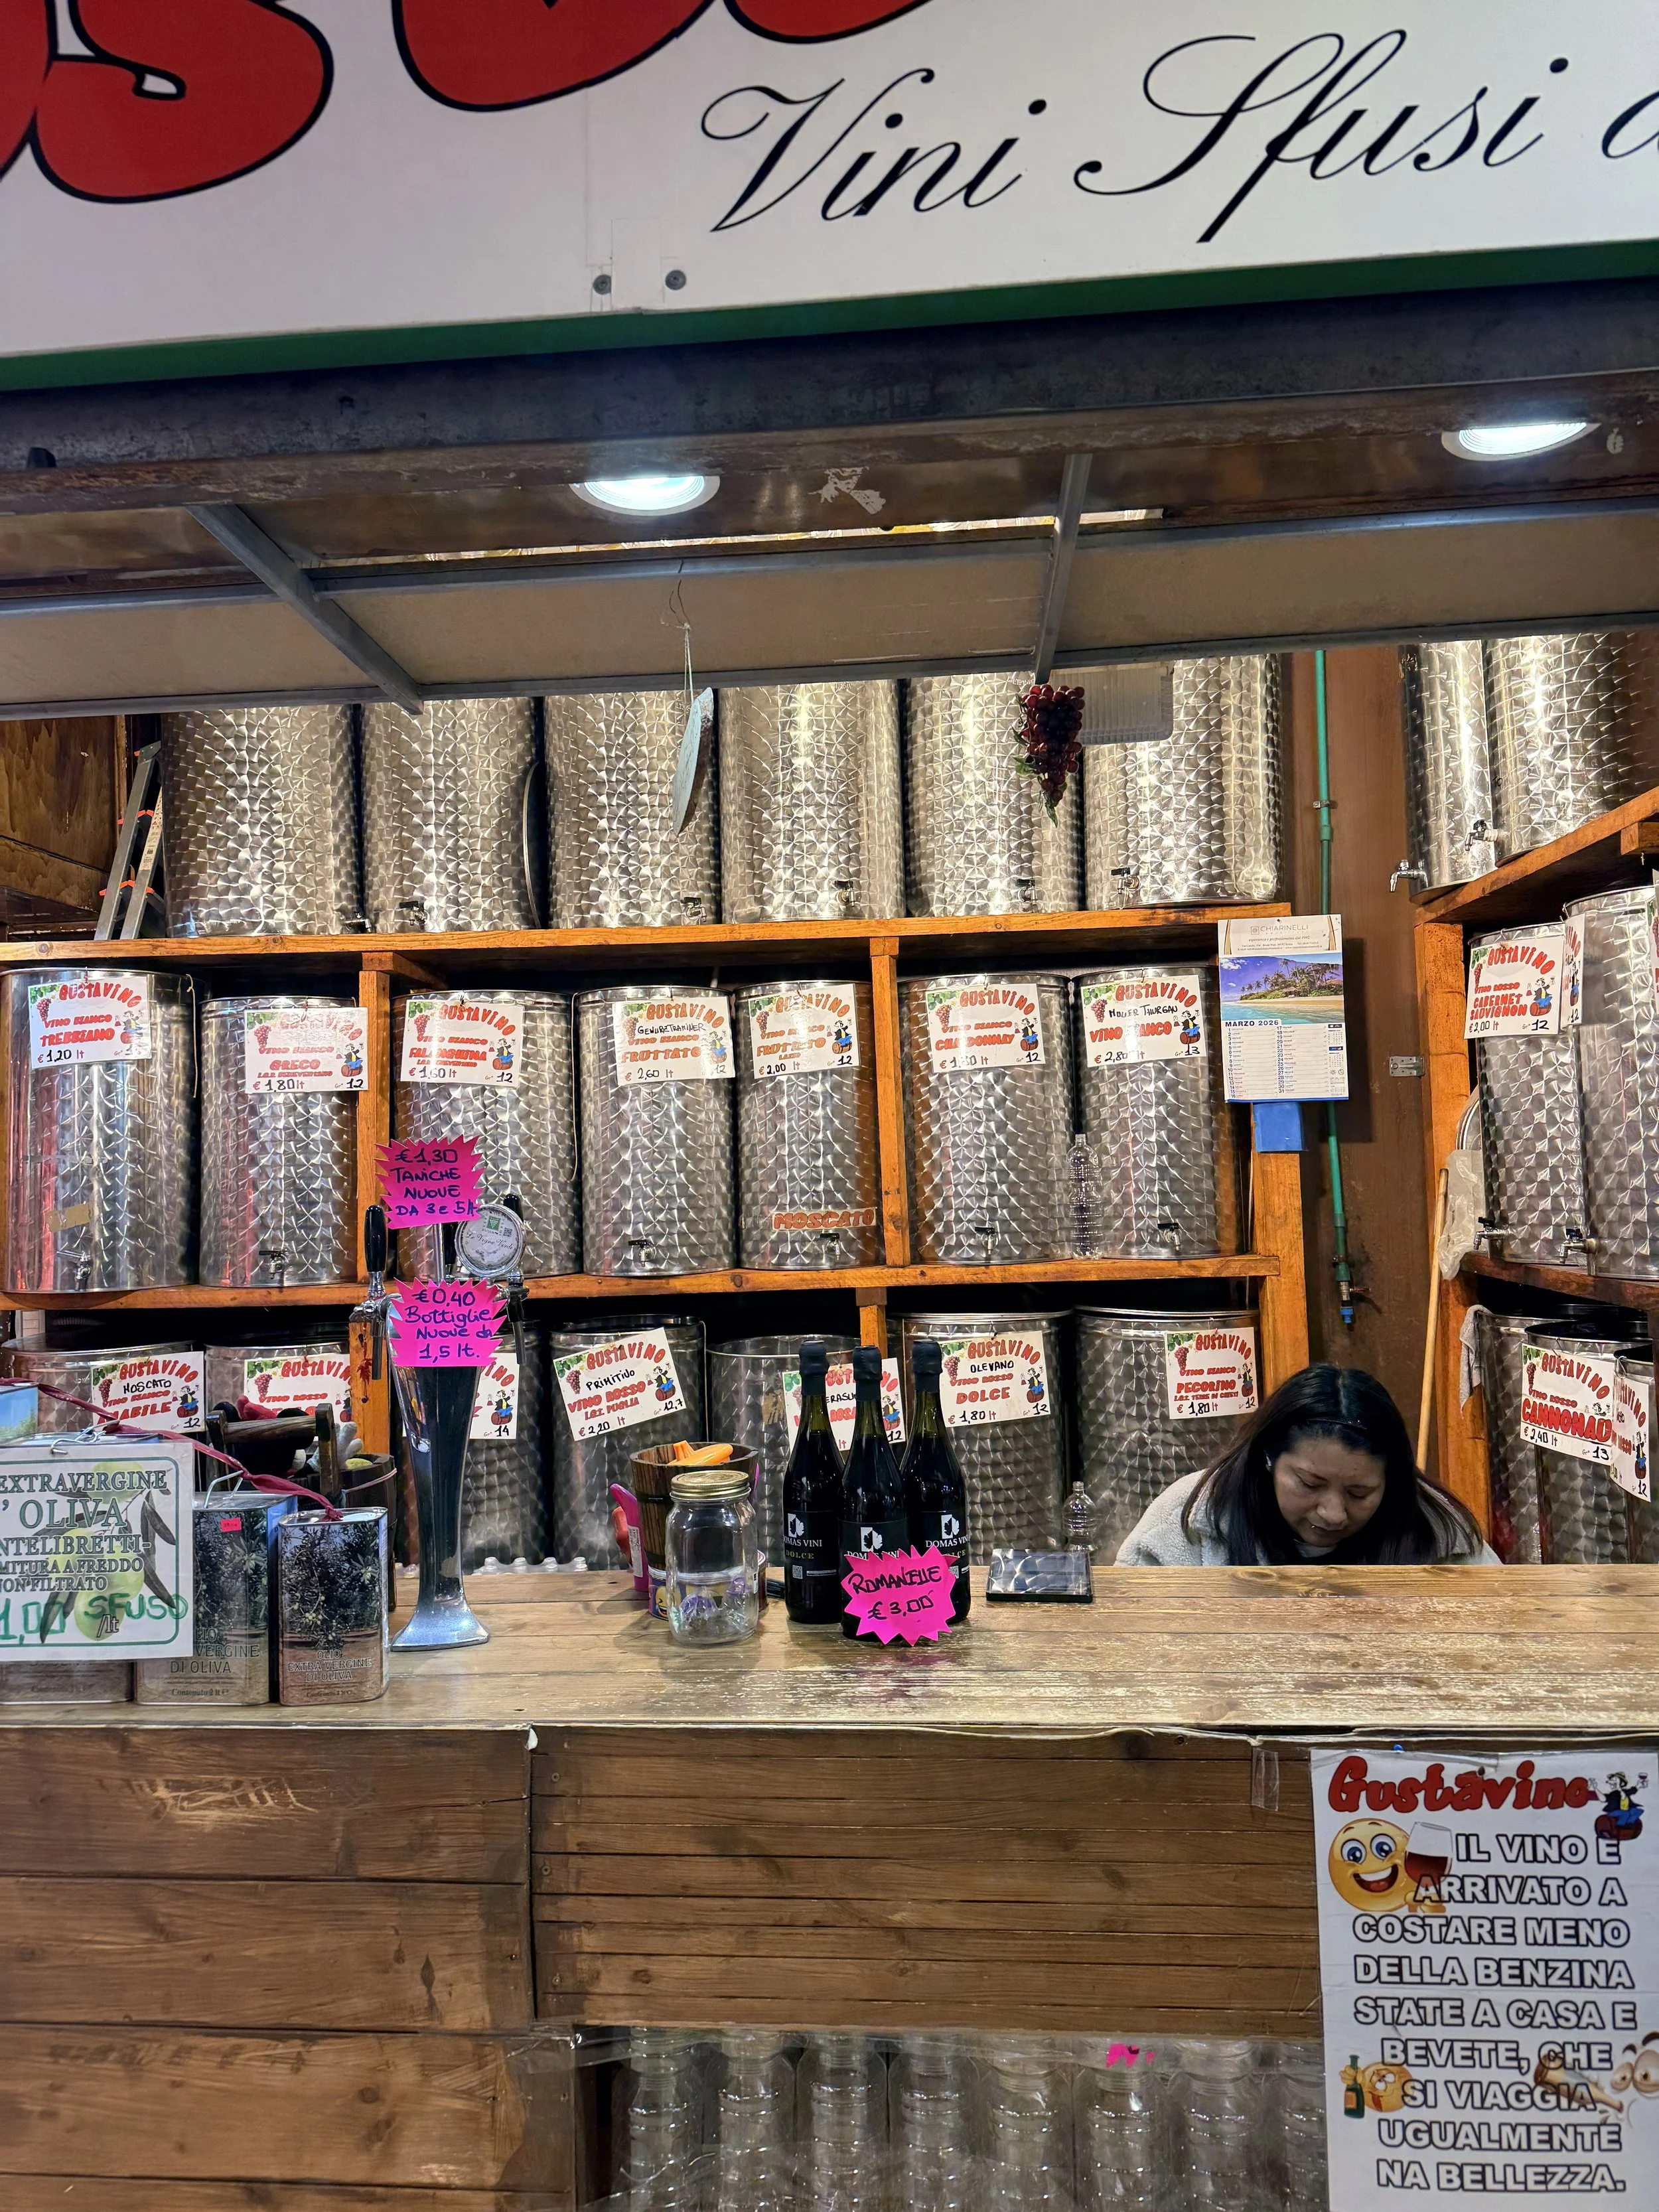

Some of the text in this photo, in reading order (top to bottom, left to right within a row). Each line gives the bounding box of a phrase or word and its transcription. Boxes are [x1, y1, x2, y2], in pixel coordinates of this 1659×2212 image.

[701, 68, 1046, 232] Vini
[1073, 29, 1569, 243] Sfusi
[1488, 945, 1555, 974] GUSTAVINO
[58, 982, 142, 1007] GUSTAVINO
[1116, 982, 1197, 1007] GUSTAVINO
[1475, 986, 1491, 994] VINO
[960, 989, 1035, 1015] GUSTAVINO
[1473, 994, 1522, 1009] CABERNET
[439, 1004, 516, 1035] GUSTAVINO
[646, 1003, 724, 1029] GUSTAVINO
[1471, 1004, 1527, 1021] SAUVIGNON
[44, 1014, 112, 1028] VINO BIANCO
[1531, 1019, 1550, 1031] 12
[40, 1028, 115, 1047] TREBBIANO
[628, 1035, 699, 1046] VINO BIANCO
[760, 1030, 785, 1039] VINO
[935, 1034, 1015, 1051] CHADONNAY
[1090, 1026, 1123, 1043] VINO
[46, 1049, 72, 1062] 1,20
[409, 1047, 487, 1061] FALNGHINA
[621, 1047, 701, 1063] FRUTTATO
[1025, 1052, 1041, 1063] 12
[1185, 1043, 1200, 1056] 13
[269, 1059, 321, 1070] GRECO
[837, 1055, 853, 1065] 12
[346, 1078, 364, 1089] 12
[496, 1072, 513, 1082] 12
[390, 1167, 461, 1183] TANICHE
[403, 1185, 461, 1199] NUOVE
[395, 1205, 419, 1216] DA
[425, 1203, 435, 1215] 3
[773, 1209, 875, 1229] MOSCATO
[405, 1305, 492, 1328] Bottiglie
[587, 1341, 666, 1370] GUSTAVINO
[968, 1339, 1041, 1364] GUSTAVINO
[1196, 1334, 1252, 1361] GUSTAVINO
[119, 1360, 198, 1382] GUSTAVINO
[281, 1360, 351, 1386] GUSTAVIN
[970, 1360, 1014, 1373] OLEVANO
[1207, 1366, 1236, 1375] BIANCO
[950, 1373, 1013, 1386] VINO ROSSO
[1542, 1353, 1610, 1399] GUSTAVINO
[123, 1379, 171, 1394] MOSCATO
[1176, 1379, 1236, 1394] PECORINO
[102, 1390, 171, 1408] VINO BIANCO
[567, 1380, 646, 1413] VINO ROSSO
[956, 1386, 1010, 1404] DOLCE
[1246, 1396, 1256, 1409] 12
[1528, 1388, 1577, 1408] VINO ROSSO
[1033, 1403, 1048, 1415] 12
[184, 1418, 200, 1428] 12
[1522, 1398, 1612, 1442] CANNONAU
[494, 1425, 509, 1437] 14
[887, 1430, 903, 1441] 12
[1592, 1446, 1609, 1461] 13
[1638, 1479, 1648, 1497] 12
[786, 1550, 814, 1559] DOLCE
[77, 1558, 143, 1573] FREDDO
[30, 1576, 108, 1592] FILTRATO
[84, 1593, 188, 1619] SFUSO
[196, 1644, 259, 1658] VERGINE
[317, 1649, 341, 1659] OLIO
[171, 1660, 231, 1673] DI OLIVA
[287, 1657, 372, 1672] EXTRA VERGINE
[306, 1670, 352, 1682] DI OLIVA
[1328, 1755, 1591, 1814] Gustavino
[1455, 1833, 1490, 1863] IL
[1496, 1833, 1589, 1864] VINO
[1413, 1874, 1628, 1907] ARRIVATO A
[1352, 1913, 1631, 1949] COSTARE MENO
[1353, 1954, 1635, 1990] DELLA BENZINA
[1354, 1996, 1637, 2031] STATE A CASA E
[1381, 2037, 1613, 2075] BEVETE, CHE
[1402, 2079, 1597, 2111] SI VIAGGIA
[1378, 2118, 1622, 2152] UGUALMENTE
[1376, 2159, 1627, 2193] NA BELLEZZA.
